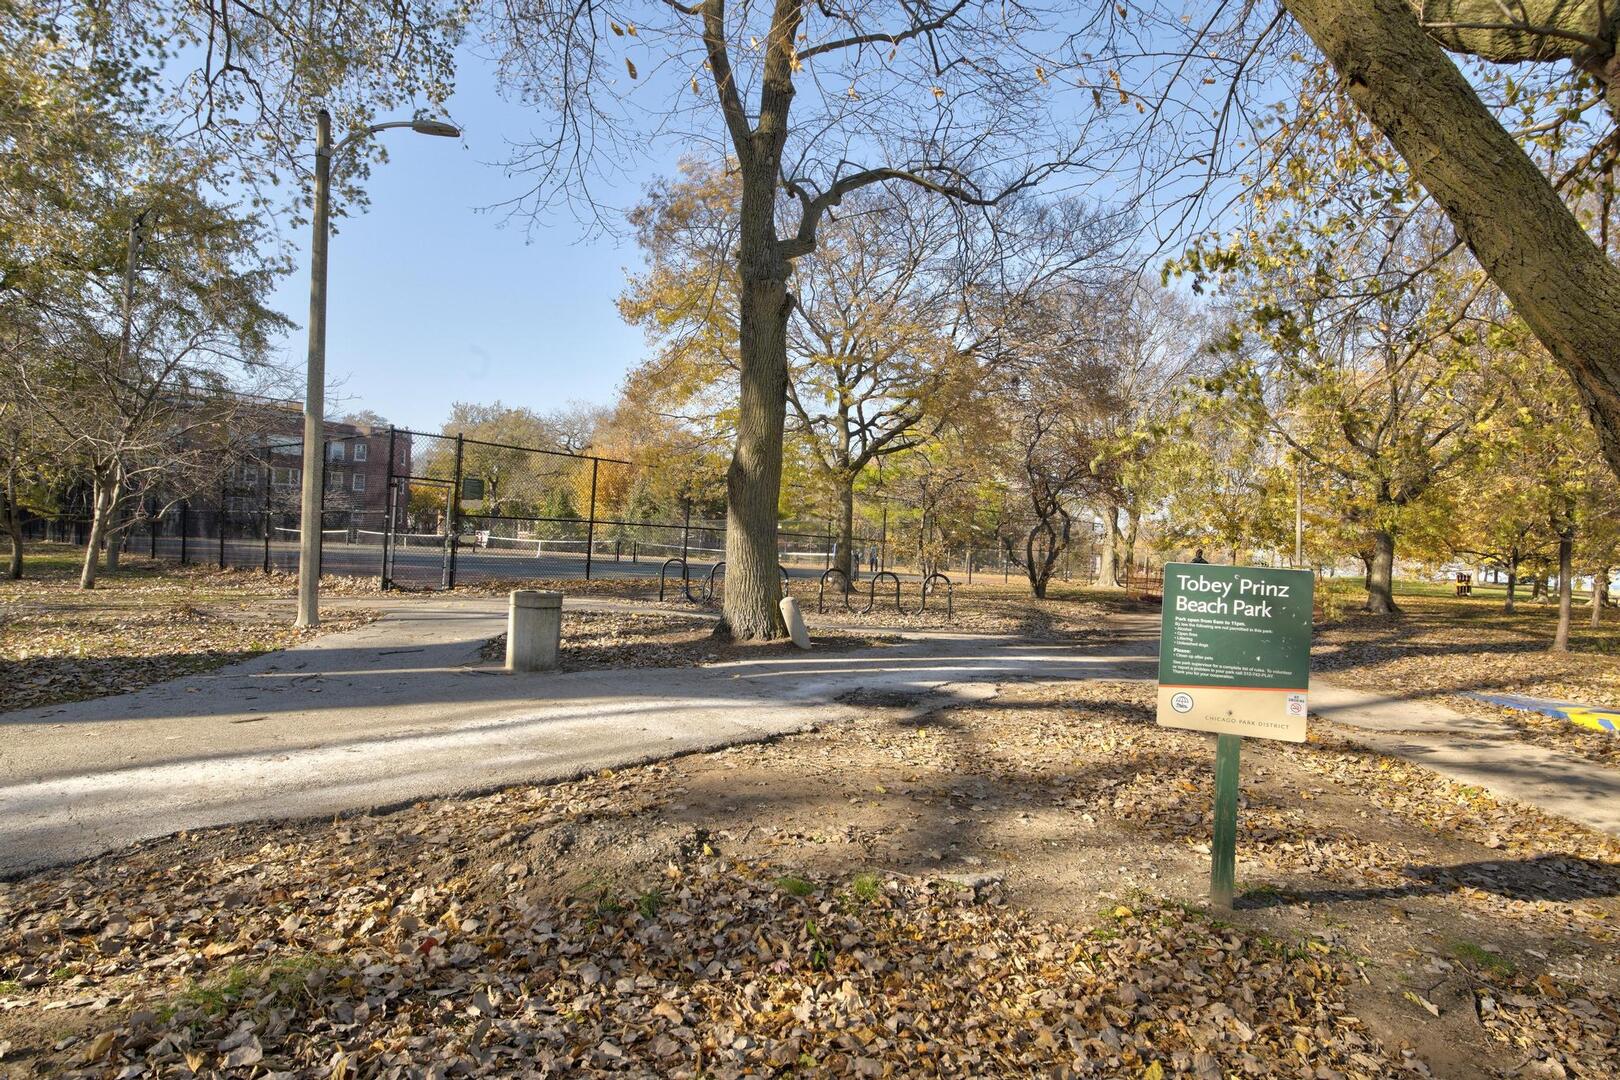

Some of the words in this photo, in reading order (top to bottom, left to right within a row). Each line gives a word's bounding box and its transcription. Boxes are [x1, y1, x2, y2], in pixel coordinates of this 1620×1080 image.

[1176, 574, 1232, 598] Tobey
[1240, 578, 1290, 598] Prinz
[1176, 595, 1227, 614] Beach
[1233, 600, 1272, 618] Park
[1258, 721, 1289, 730] DISTRICT
